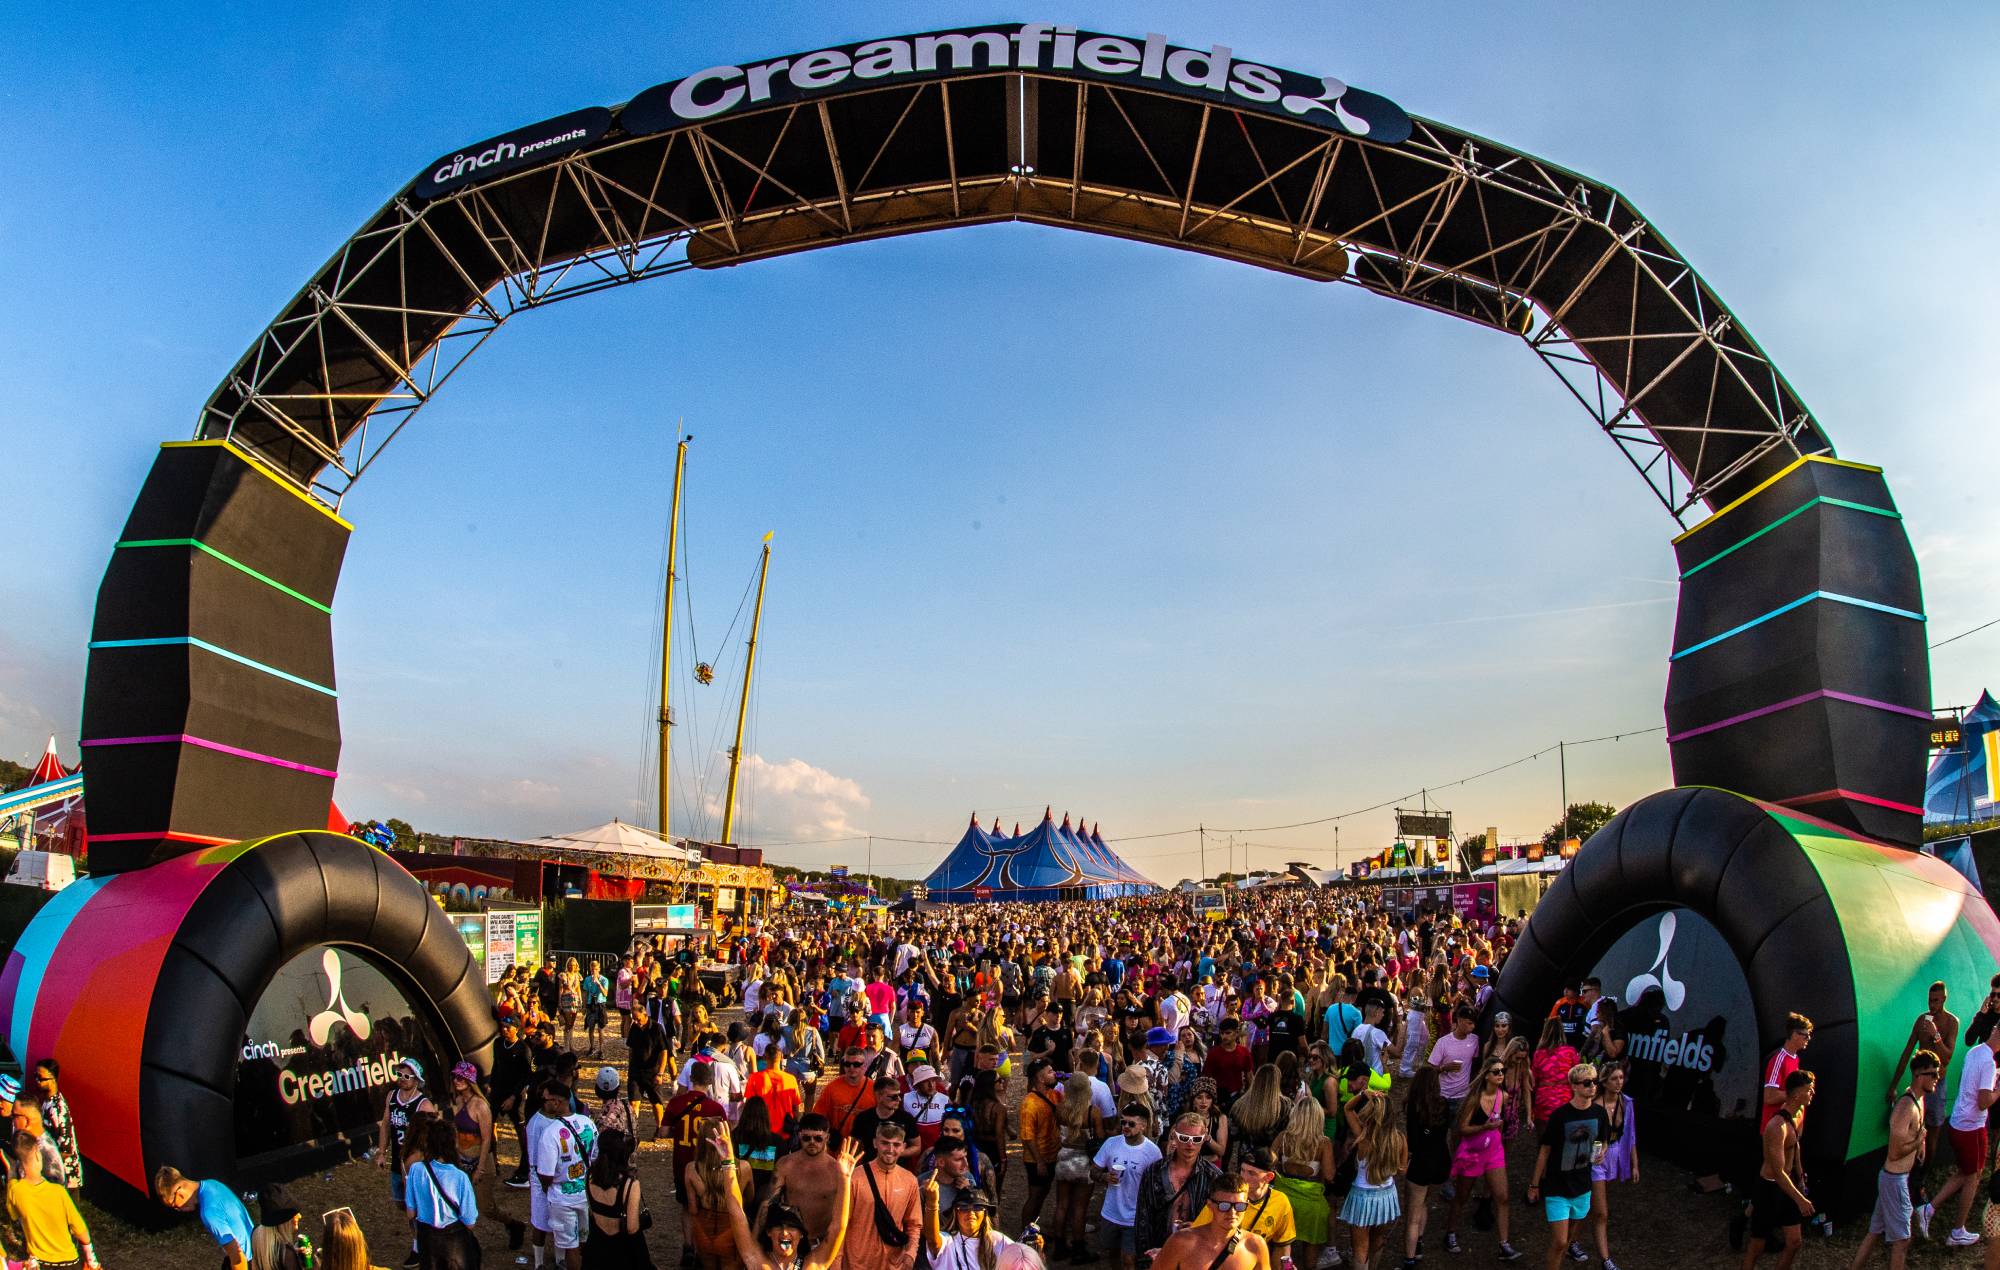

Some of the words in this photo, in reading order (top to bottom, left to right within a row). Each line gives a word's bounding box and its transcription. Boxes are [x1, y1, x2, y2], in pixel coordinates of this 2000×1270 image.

[669, 22, 1281, 120] Creamfields
[433, 142, 516, 184] cinch
[519, 128, 586, 158] presents
[243, 1039, 280, 1060] cinch
[281, 1046, 306, 1058] presents
[1627, 1028, 1714, 1072] mfields
[911, 1102, 940, 1110] CHER
